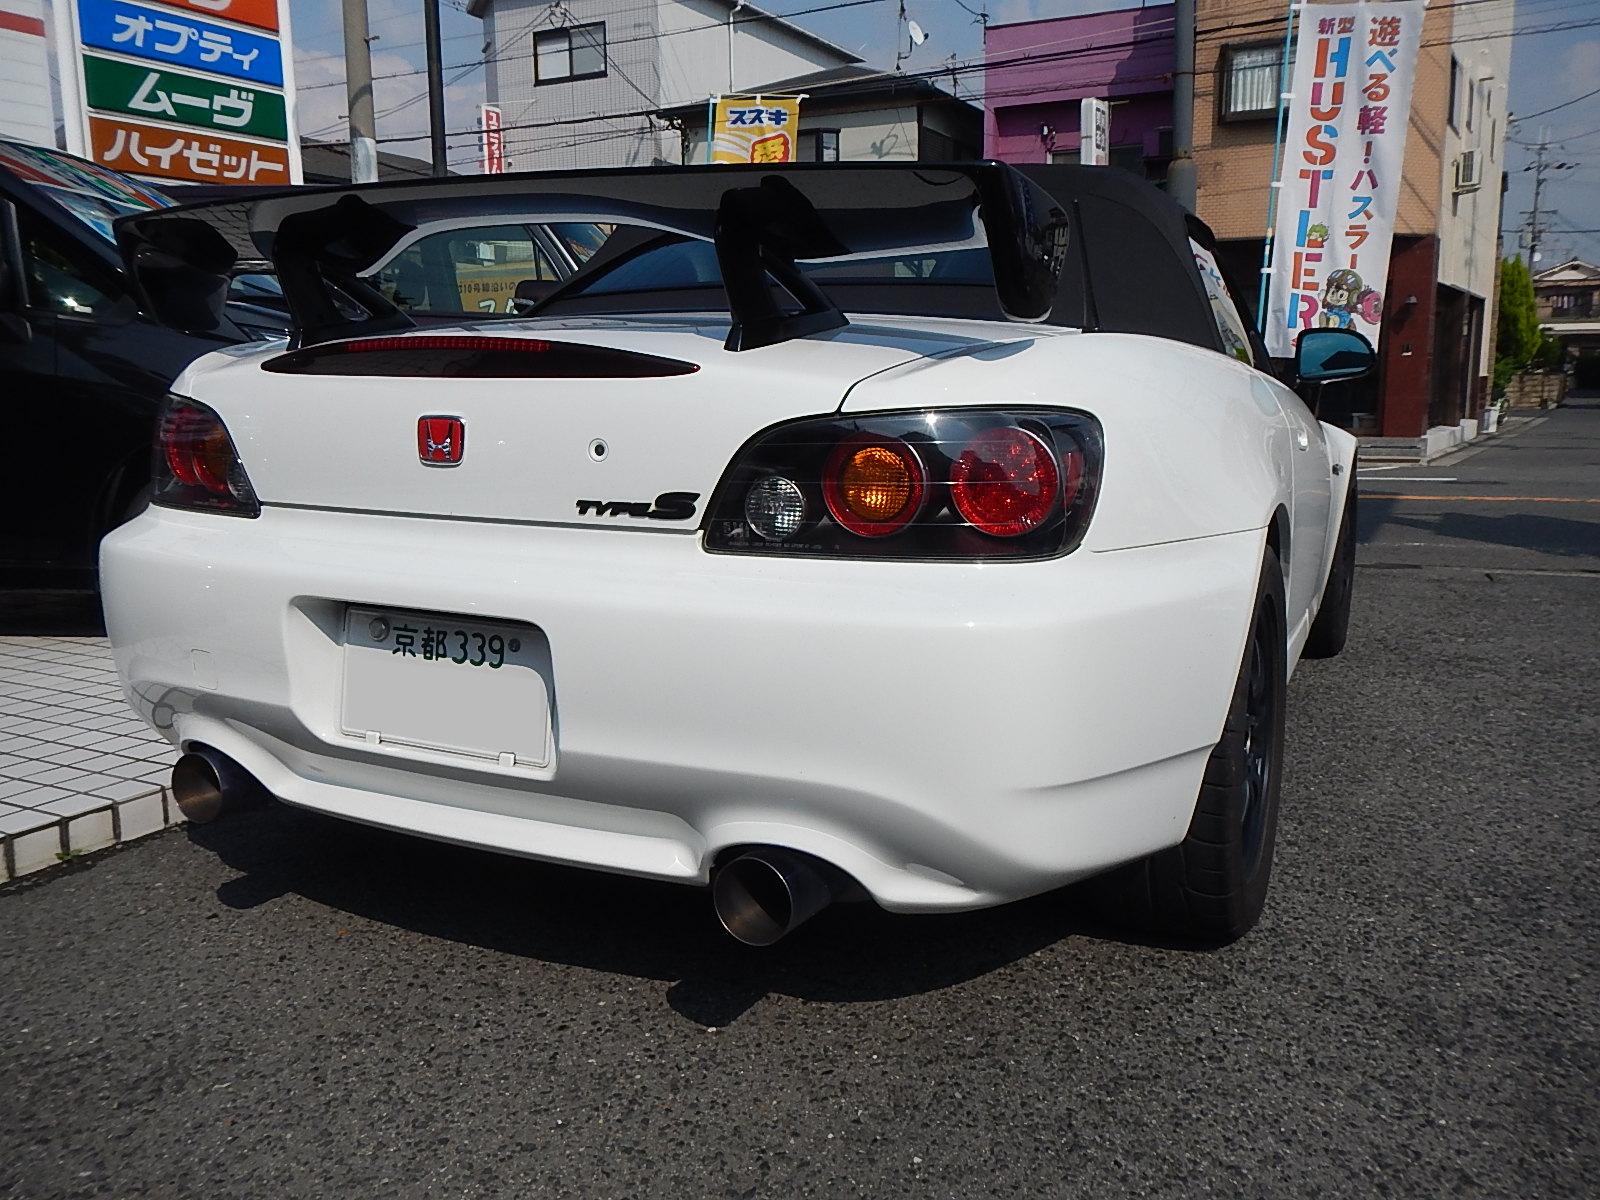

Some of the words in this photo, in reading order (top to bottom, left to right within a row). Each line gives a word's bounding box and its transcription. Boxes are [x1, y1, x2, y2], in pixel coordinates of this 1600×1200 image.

[112, 14, 259, 71] オプティ
[1318, 16, 1356, 35] 新型
[127, 72, 255, 127] ムーヴ
[729, 108, 788, 126] スズキ
[103, 129, 284, 181] ハイゼット
[1287, 37, 1352, 330] HUSTLER
